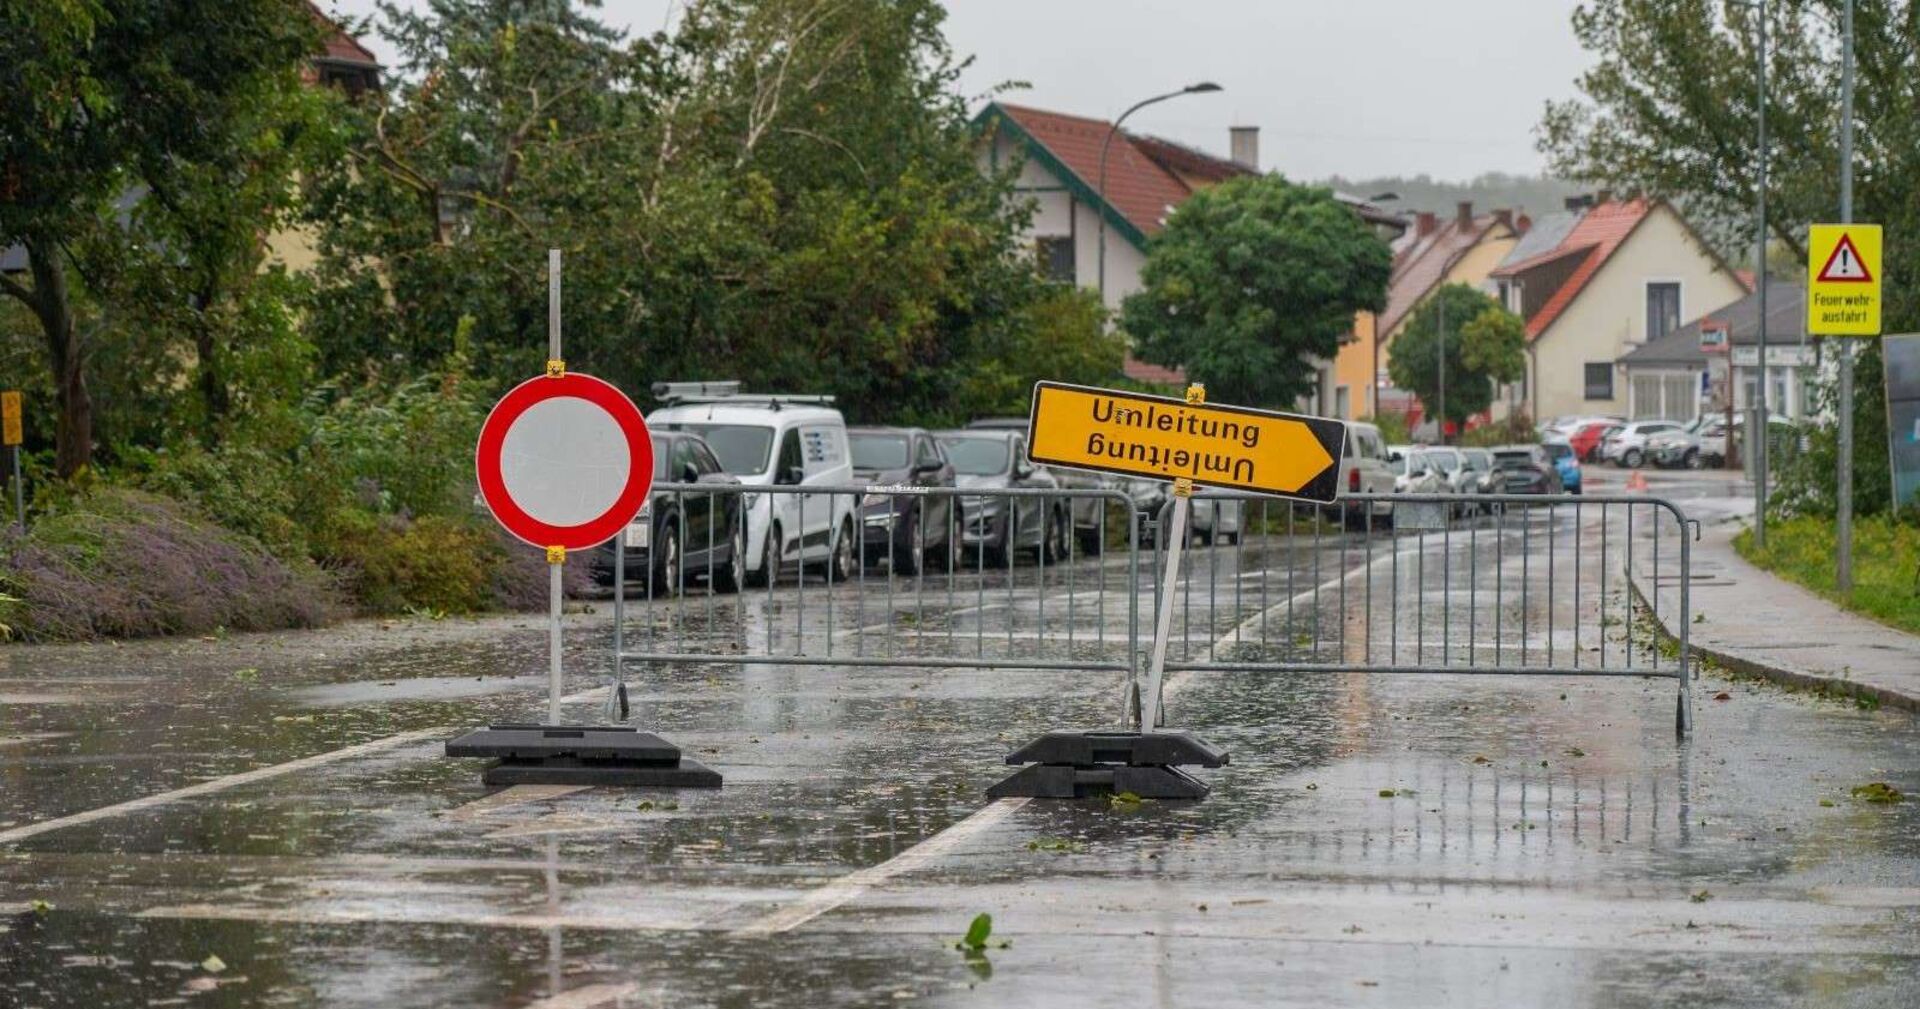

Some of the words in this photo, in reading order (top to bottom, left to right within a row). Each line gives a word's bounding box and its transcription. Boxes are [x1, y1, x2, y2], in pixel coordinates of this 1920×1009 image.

[1814, 293, 1874, 305] Feuerwehr-
[1821, 310, 1867, 323] ausfahrt
[1093, 398, 1260, 448] Umleitung
[1087, 433, 1254, 483] Umleitung
